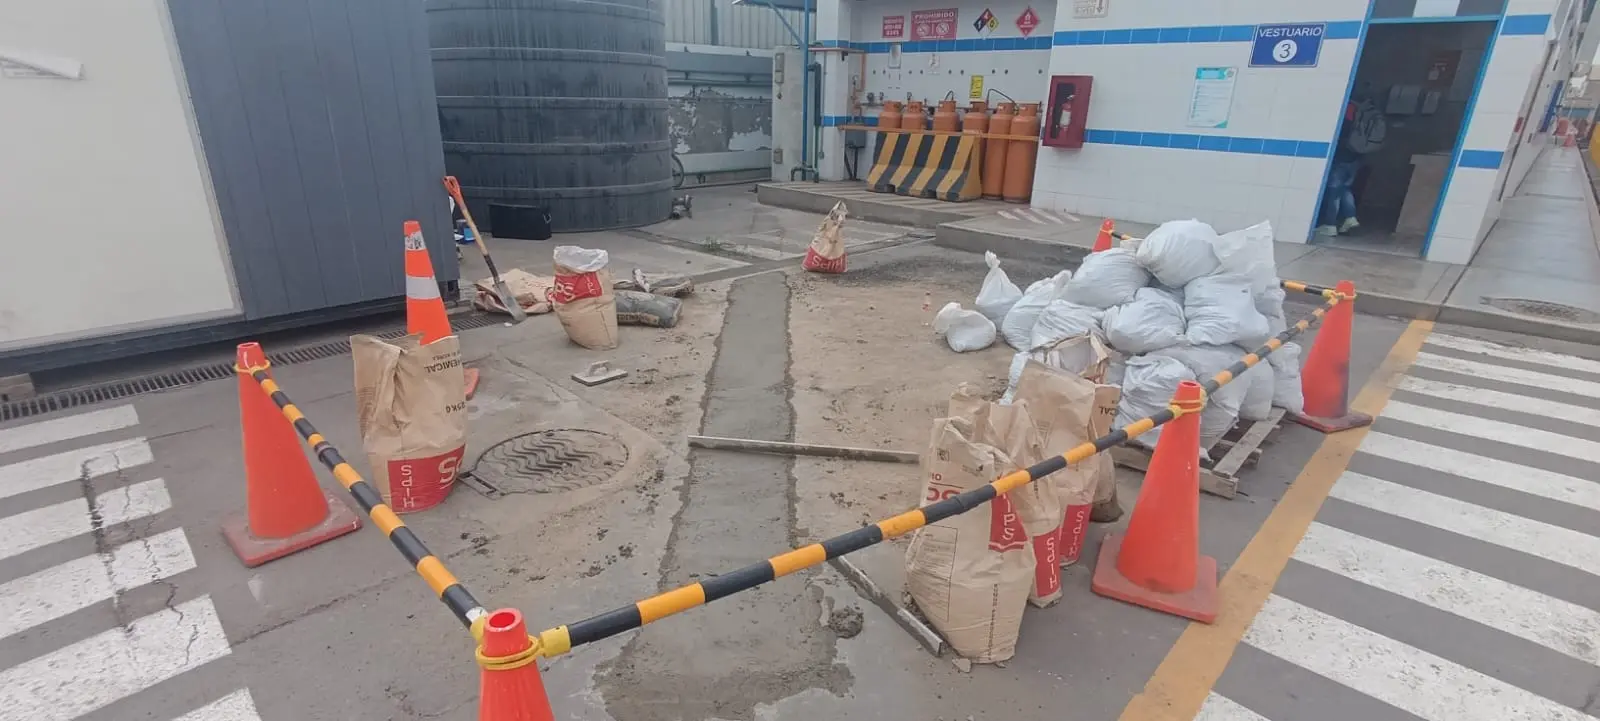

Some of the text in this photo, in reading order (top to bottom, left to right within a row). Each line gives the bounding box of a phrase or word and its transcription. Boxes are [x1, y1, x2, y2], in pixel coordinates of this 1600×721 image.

[1260, 27, 1322, 37] VESTUARIO
[1279, 43, 1291, 58] 3
[400, 464, 415, 508] HIPS
[1002, 493, 1016, 541] IPS
[1069, 510, 1085, 557] HIPS
[1046, 537, 1058, 589] HIPS
